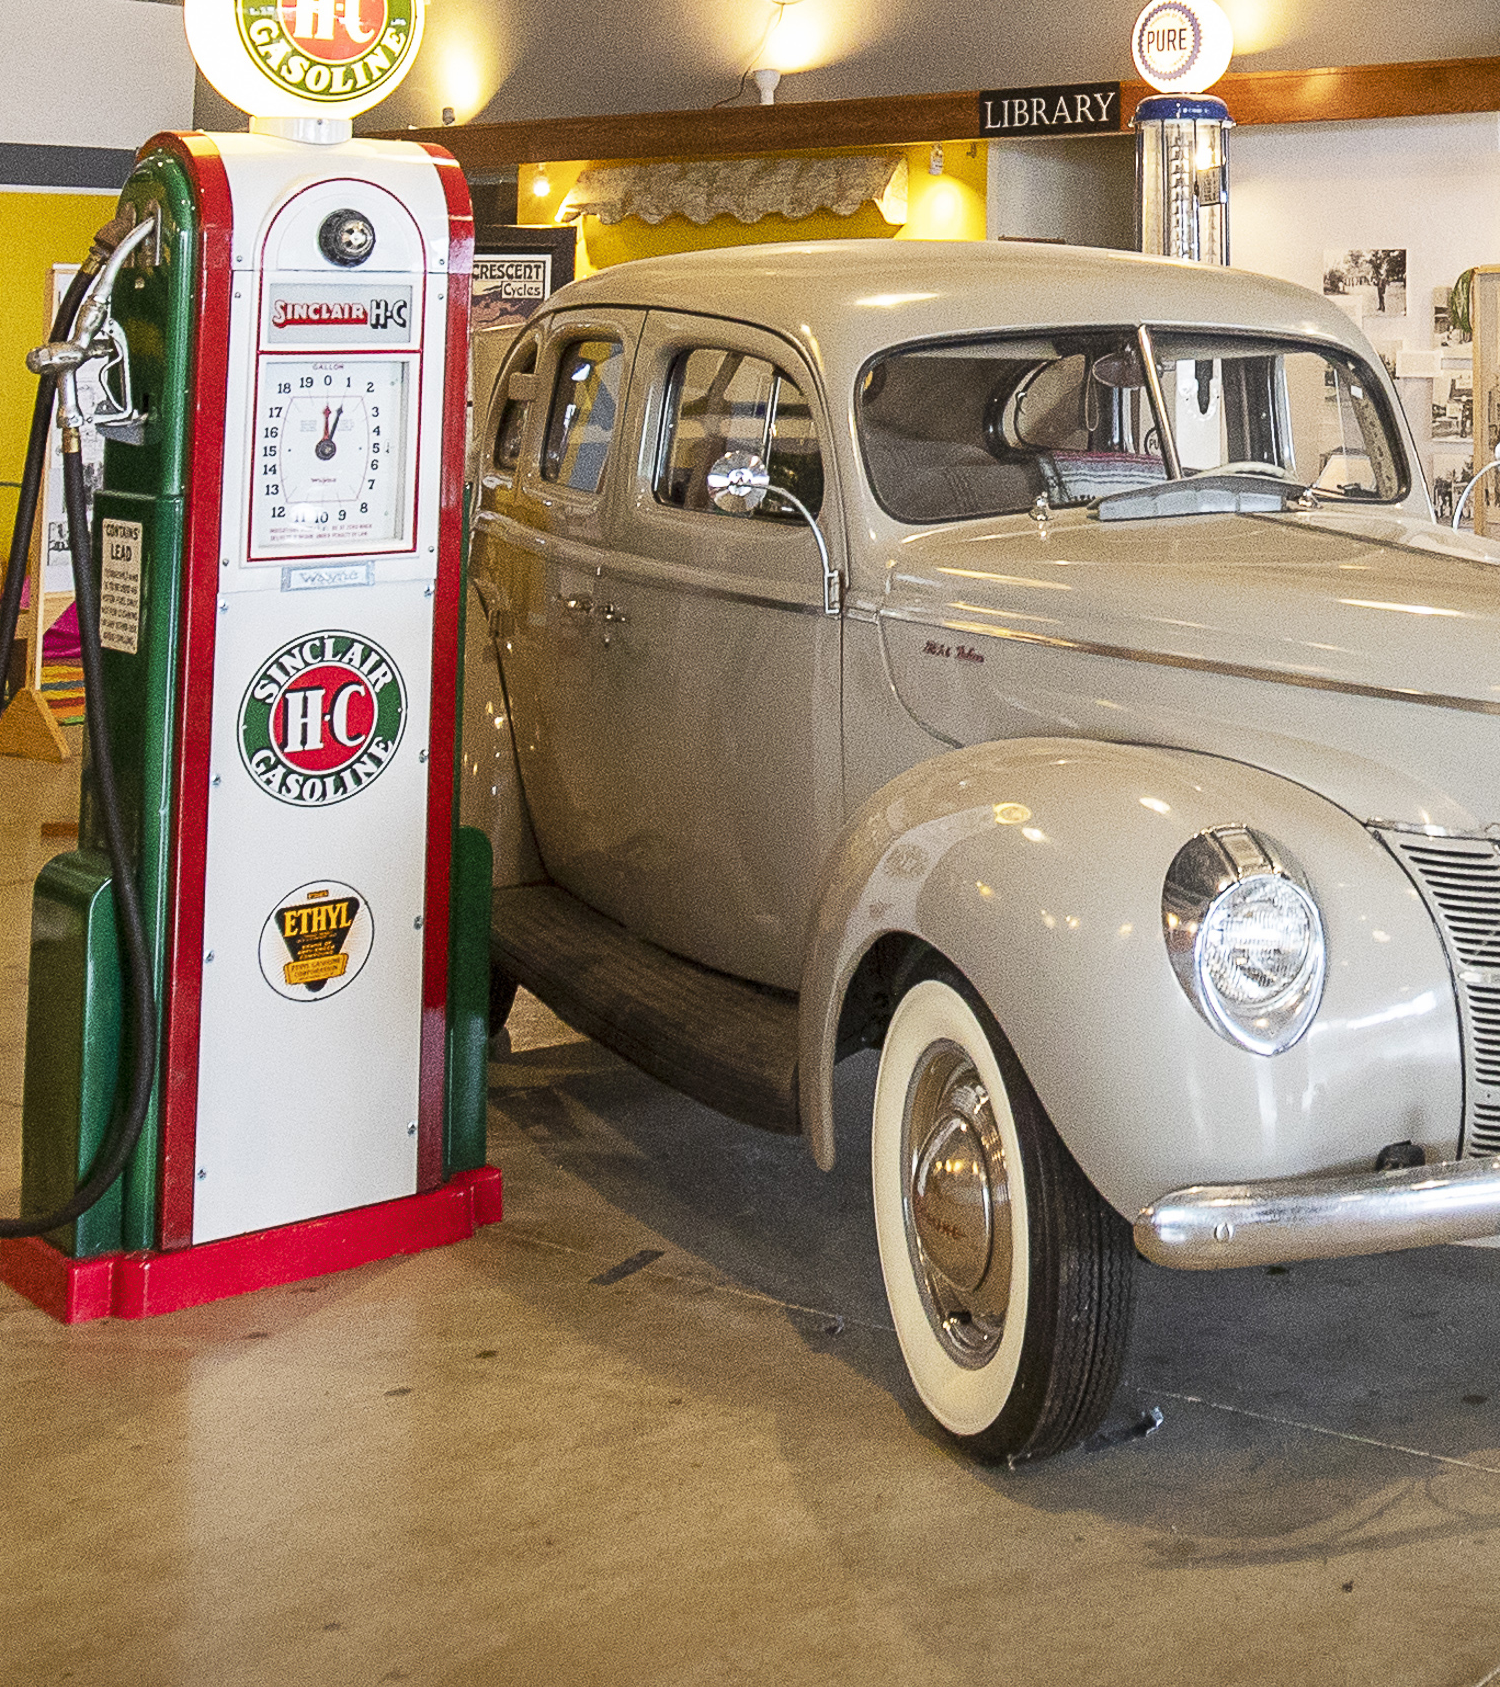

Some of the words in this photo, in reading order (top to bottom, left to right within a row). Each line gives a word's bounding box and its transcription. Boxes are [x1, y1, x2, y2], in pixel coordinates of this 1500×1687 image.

[1147, 28, 1187, 54] PURE
[249, 18, 407, 94] GASOLINE
[984, 91, 1116, 129] LIBRARY
[472, 263, 542, 279] CRESCENT
[503, 282, 541, 296] Cycles
[272, 298, 368, 329] SINCLAIR
[299, 376, 314, 388] 19
[323, 375, 333, 386] 0
[346, 376, 352, 388] 1
[277, 382, 292, 394] 18
[366, 381, 375, 393] 2
[268, 406, 283, 418] 17
[371, 406, 380, 417] 3
[264, 426, 279, 438] 16
[372, 425, 381, 437] 4
[262, 445, 277, 457] 15
[372, 442, 380, 454] 5
[262, 464, 277, 476] 14
[370, 459, 379, 470] 6
[264, 484, 280, 496] 13
[367, 478, 376, 490] 7
[271, 506, 286, 518] 12
[359, 502, 369, 513] 8
[314, 512, 329, 523] 10
[338, 509, 347, 521] 9
[110, 543, 133, 562] LEAD
[253, 637, 393, 704] SINCLAIR
[251, 736, 394, 802] GASOLINE
[283, 901, 353, 938] ETHYL
